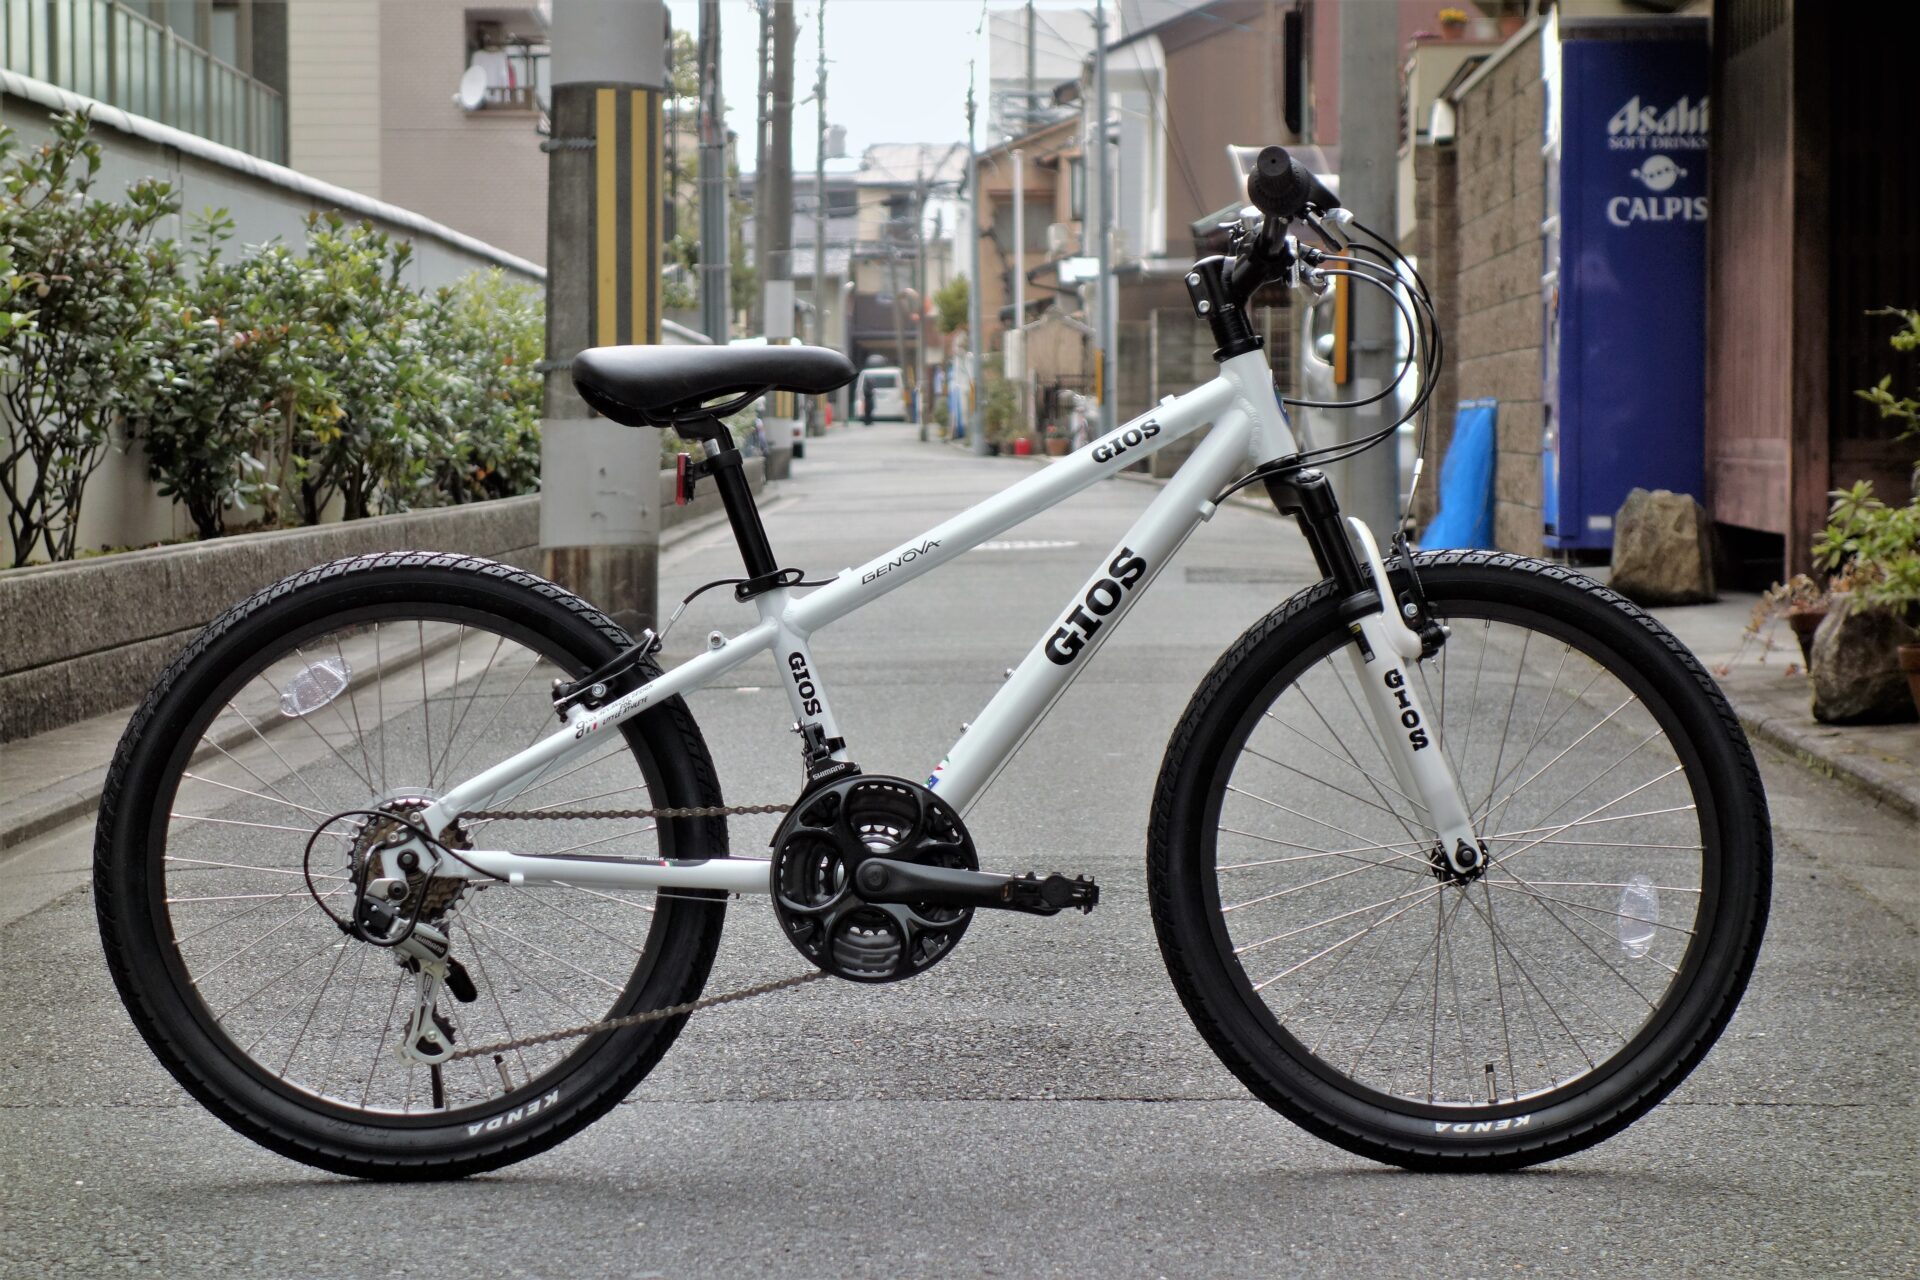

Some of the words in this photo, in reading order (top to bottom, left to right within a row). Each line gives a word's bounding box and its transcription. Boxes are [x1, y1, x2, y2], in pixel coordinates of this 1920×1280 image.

[1607, 95, 1710, 135] Asahi
[1608, 136, 1648, 149] SOFT
[1652, 136, 1708, 149] DRINKS
[1607, 196, 1708, 227] CALPIS
[1092, 418, 1161, 463] GIOS
[862, 539, 942, 585] GENOVA
[1044, 546, 1147, 666] GIOS
[788, 651, 822, 717] GIOS
[603, 710, 622, 725] LITTLE
[622, 696, 648, 714] ATHLETE
[1384, 668, 1429, 751] GIOS
[812, 763, 846, 780] SHIMANO
[414, 933, 445, 953] SHIMANO
[467, 1089, 560, 1136] KENDA
[1435, 1114, 1531, 1133] KENDA
